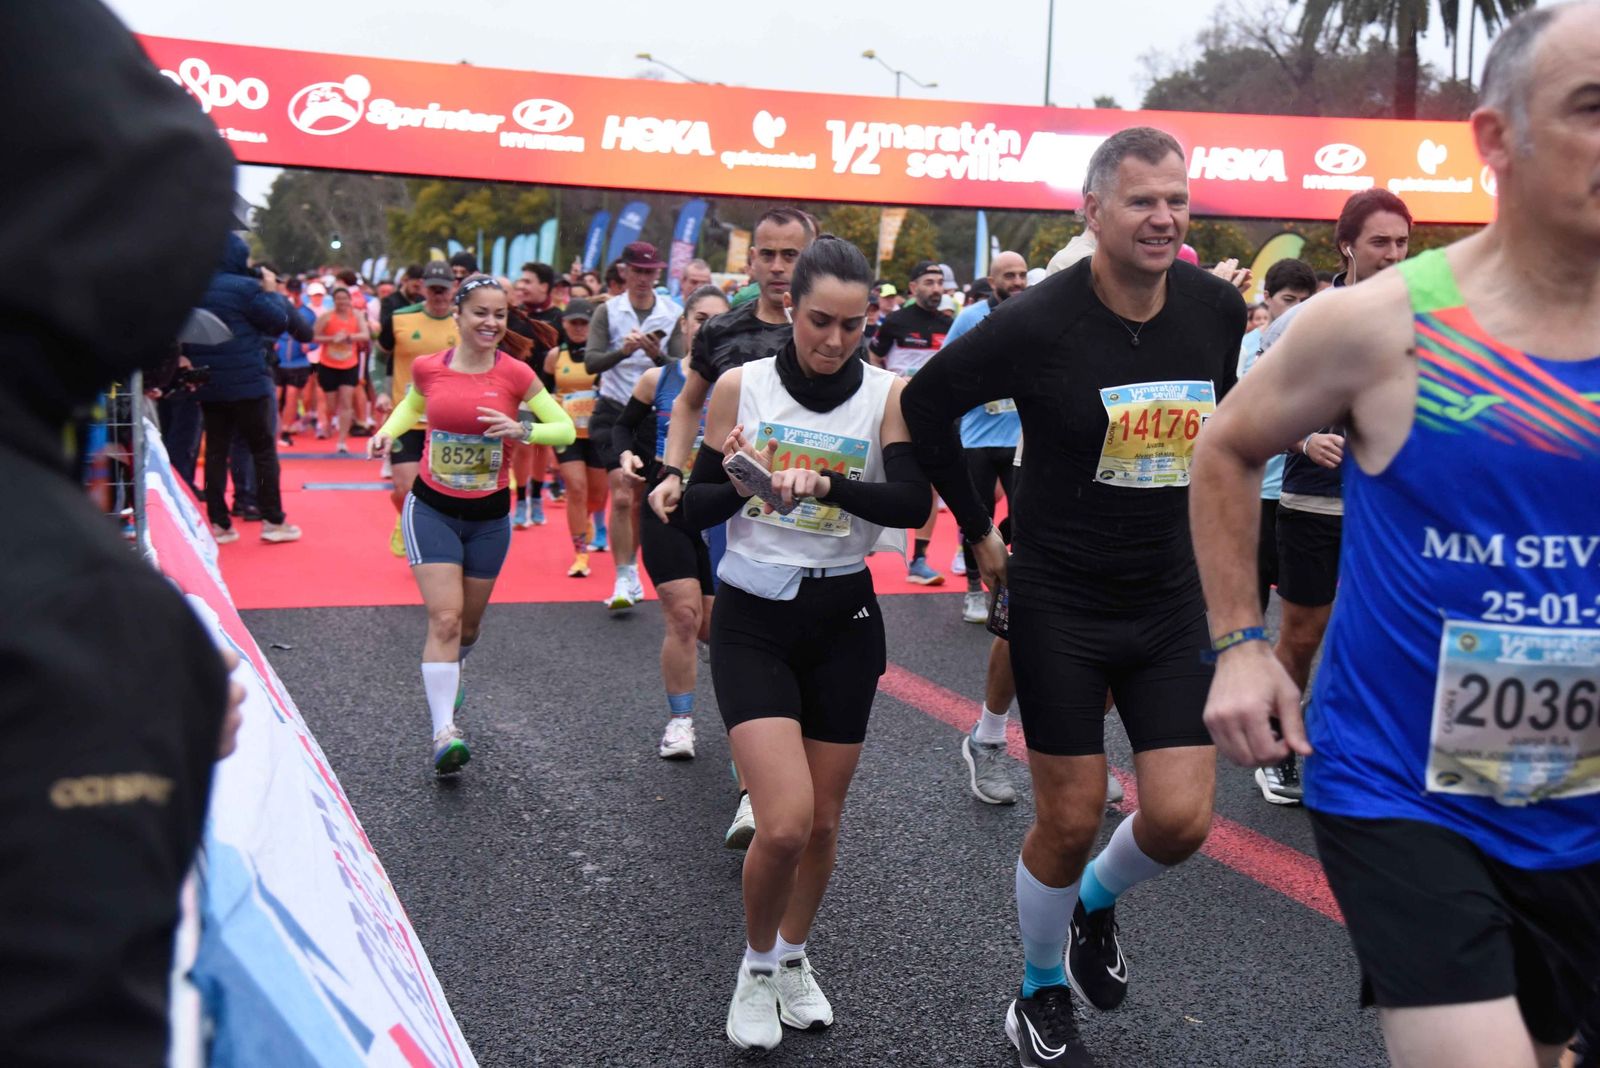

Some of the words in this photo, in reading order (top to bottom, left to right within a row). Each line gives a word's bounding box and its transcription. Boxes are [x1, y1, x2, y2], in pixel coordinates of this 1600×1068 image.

[366, 99, 506, 130] Sprinter
[601, 115, 715, 156] HOKA
[868, 121, 1021, 155] maratón
[906, 151, 1034, 183] sevilla
[1189, 146, 1288, 182] HOKA
[1119, 408, 1200, 442] 14176
[441, 446, 486, 466] 8524
[1421, 526, 1505, 567] MM
[1515, 534, 1600, 568] SEV
[1455, 672, 1600, 732] 2036
